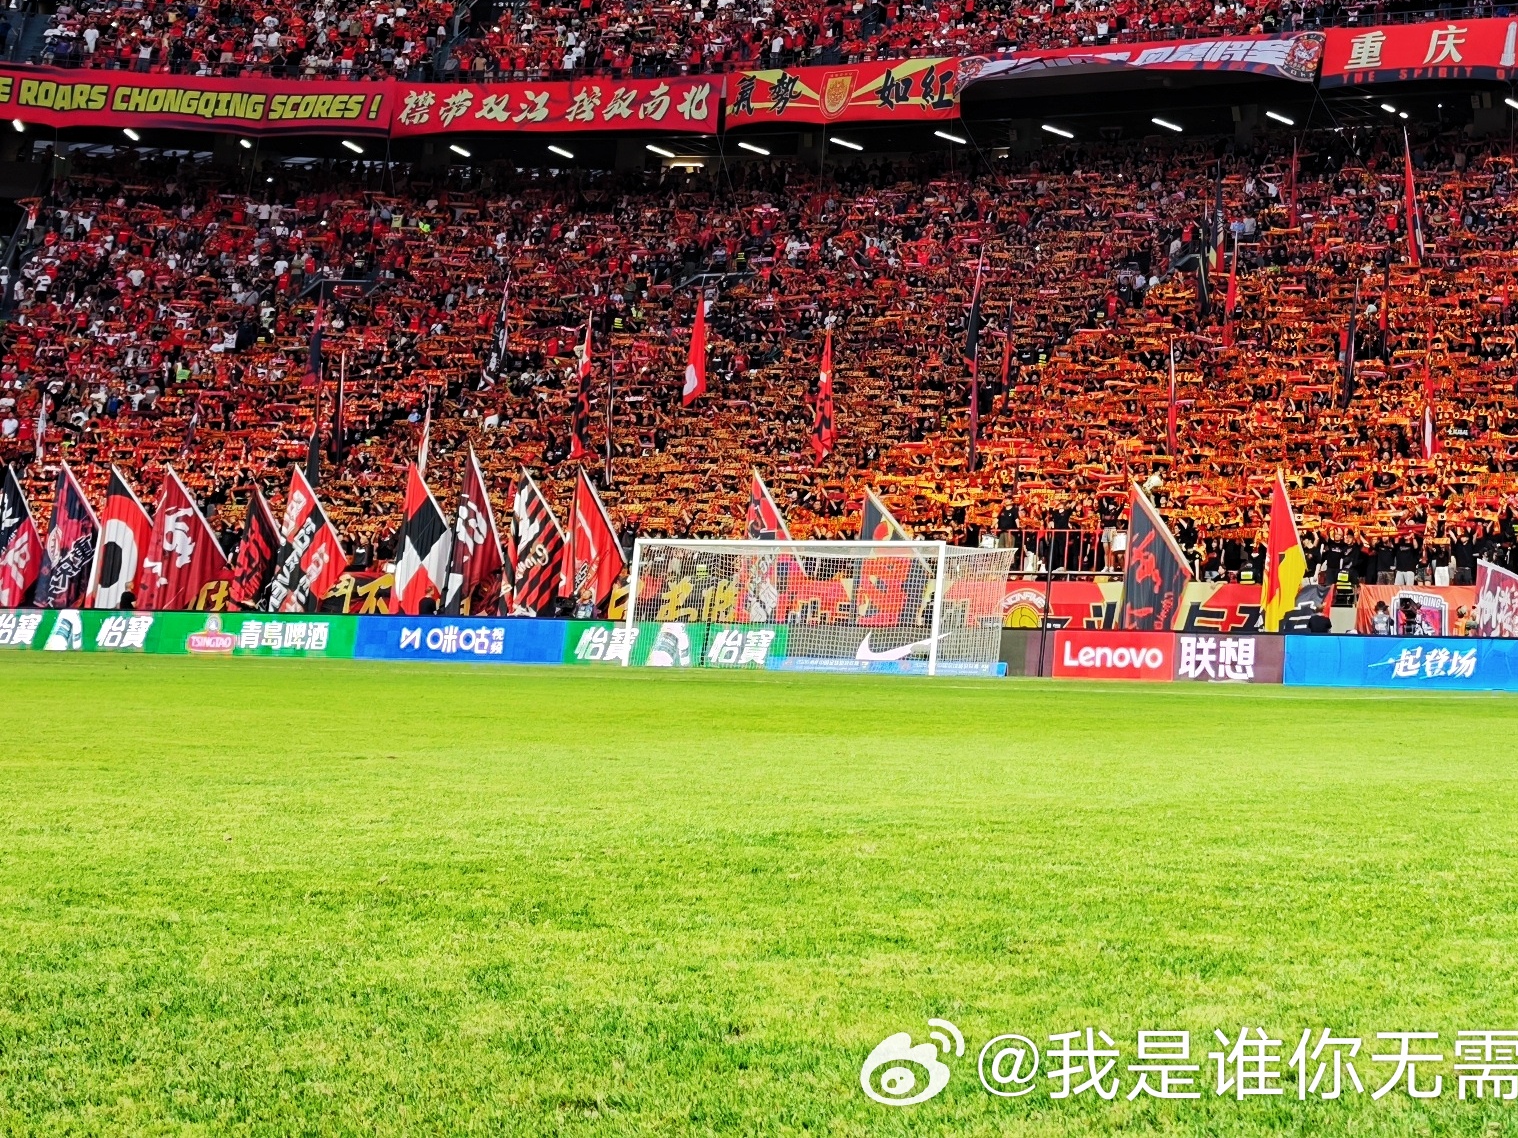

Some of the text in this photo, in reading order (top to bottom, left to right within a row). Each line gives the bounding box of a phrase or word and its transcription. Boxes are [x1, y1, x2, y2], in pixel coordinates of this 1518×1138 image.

[18, 79, 107, 111] ROARS
[112, 86, 264, 120] CHONGQING
[1063, 640, 1164, 669] Lenovo
[1178, 636, 1256, 680] 联想
